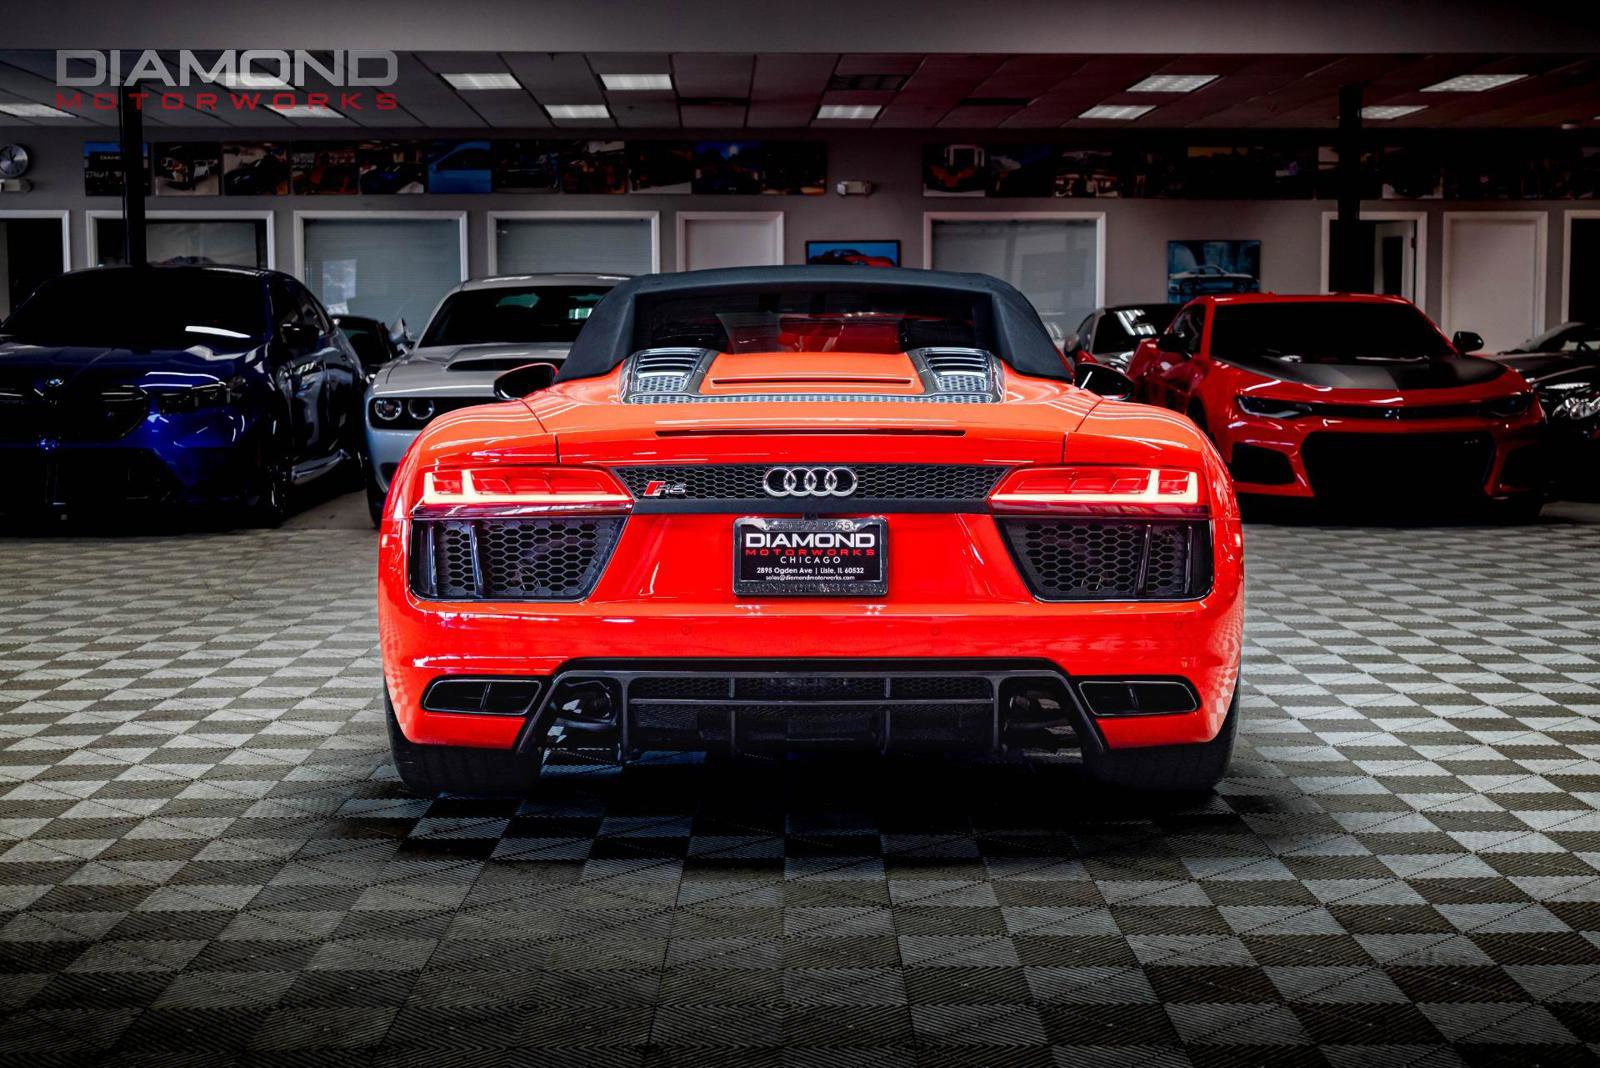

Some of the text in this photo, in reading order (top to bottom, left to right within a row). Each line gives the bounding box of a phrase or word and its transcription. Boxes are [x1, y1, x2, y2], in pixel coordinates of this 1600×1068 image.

[745, 533, 876, 548] DIAMOND
[780, 556, 841, 564] CHICAGO
[774, 567, 798, 576] Ogden
